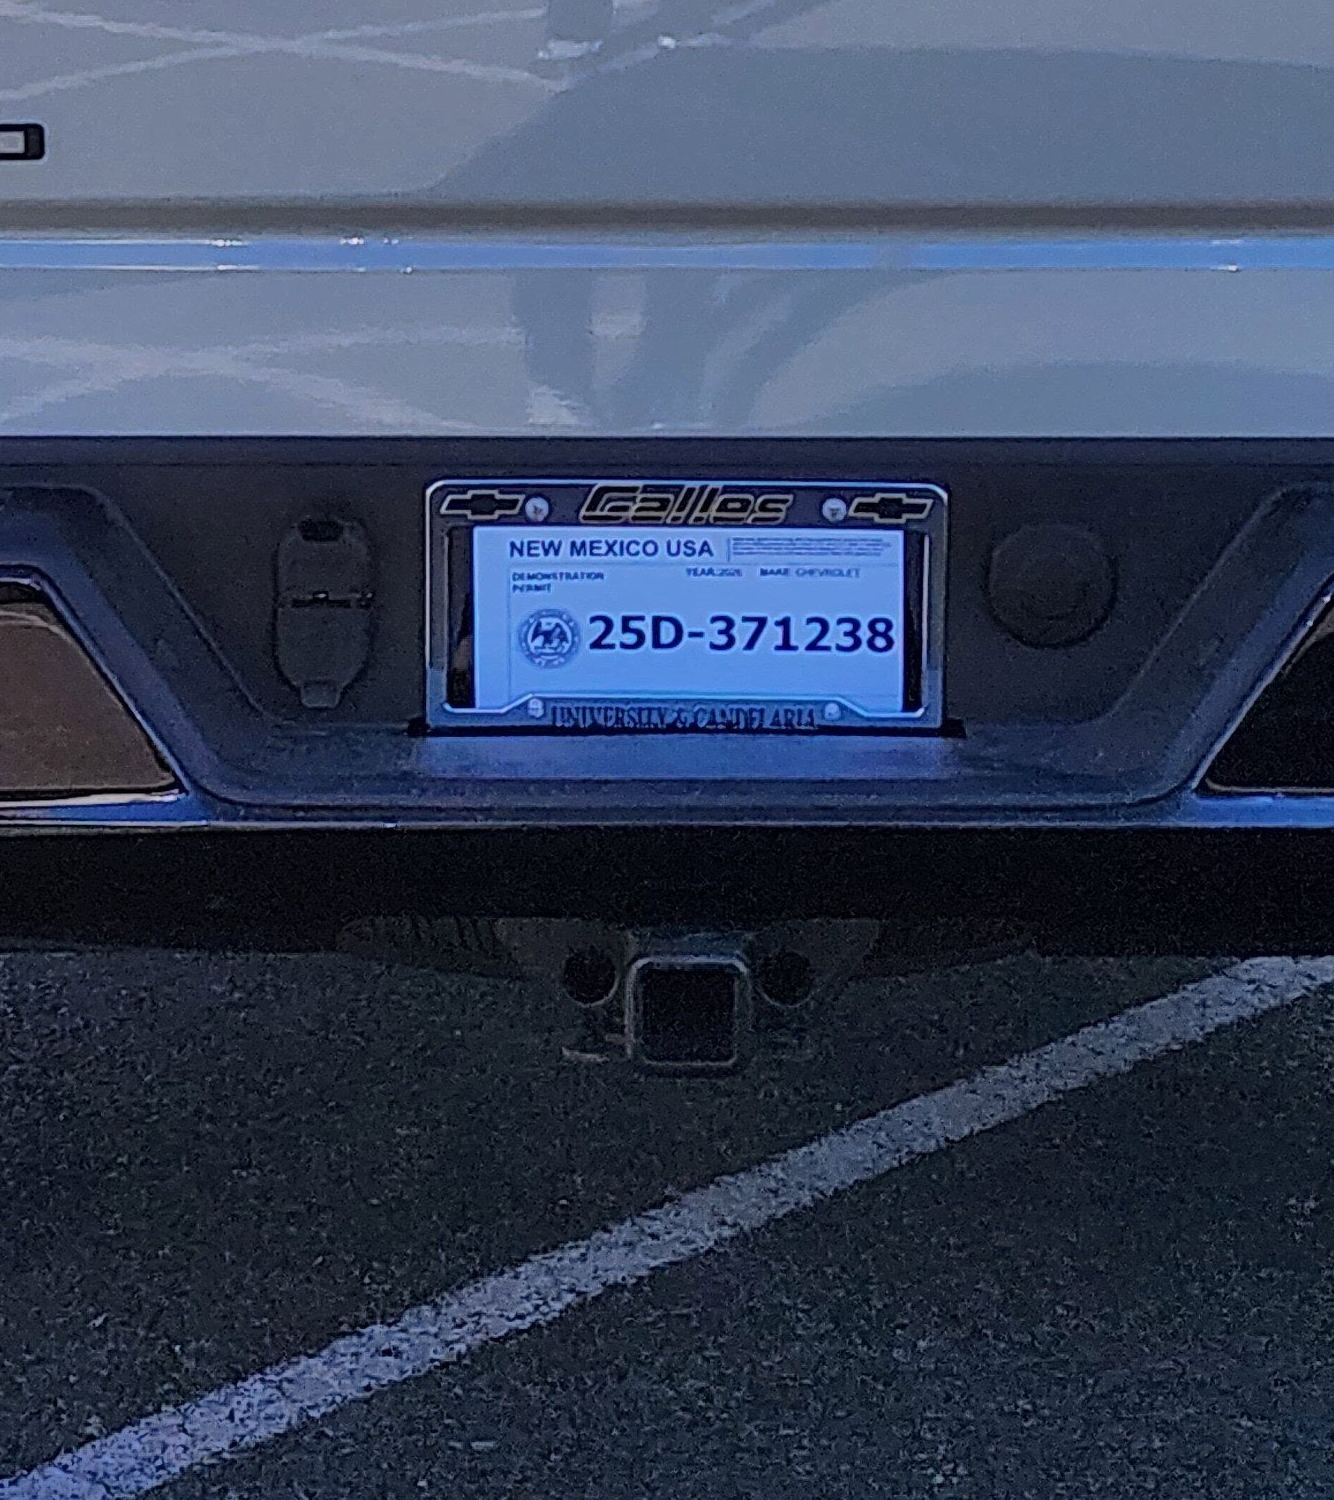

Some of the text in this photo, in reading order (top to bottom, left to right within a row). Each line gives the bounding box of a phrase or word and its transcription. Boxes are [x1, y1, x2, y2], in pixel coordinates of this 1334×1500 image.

[578, 484, 793, 524] Galles
[509, 540, 561, 557] NEW
[569, 540, 660, 557] MEXICO
[666, 539, 714, 558] USA
[588, 615, 895, 653] 25D-371238
